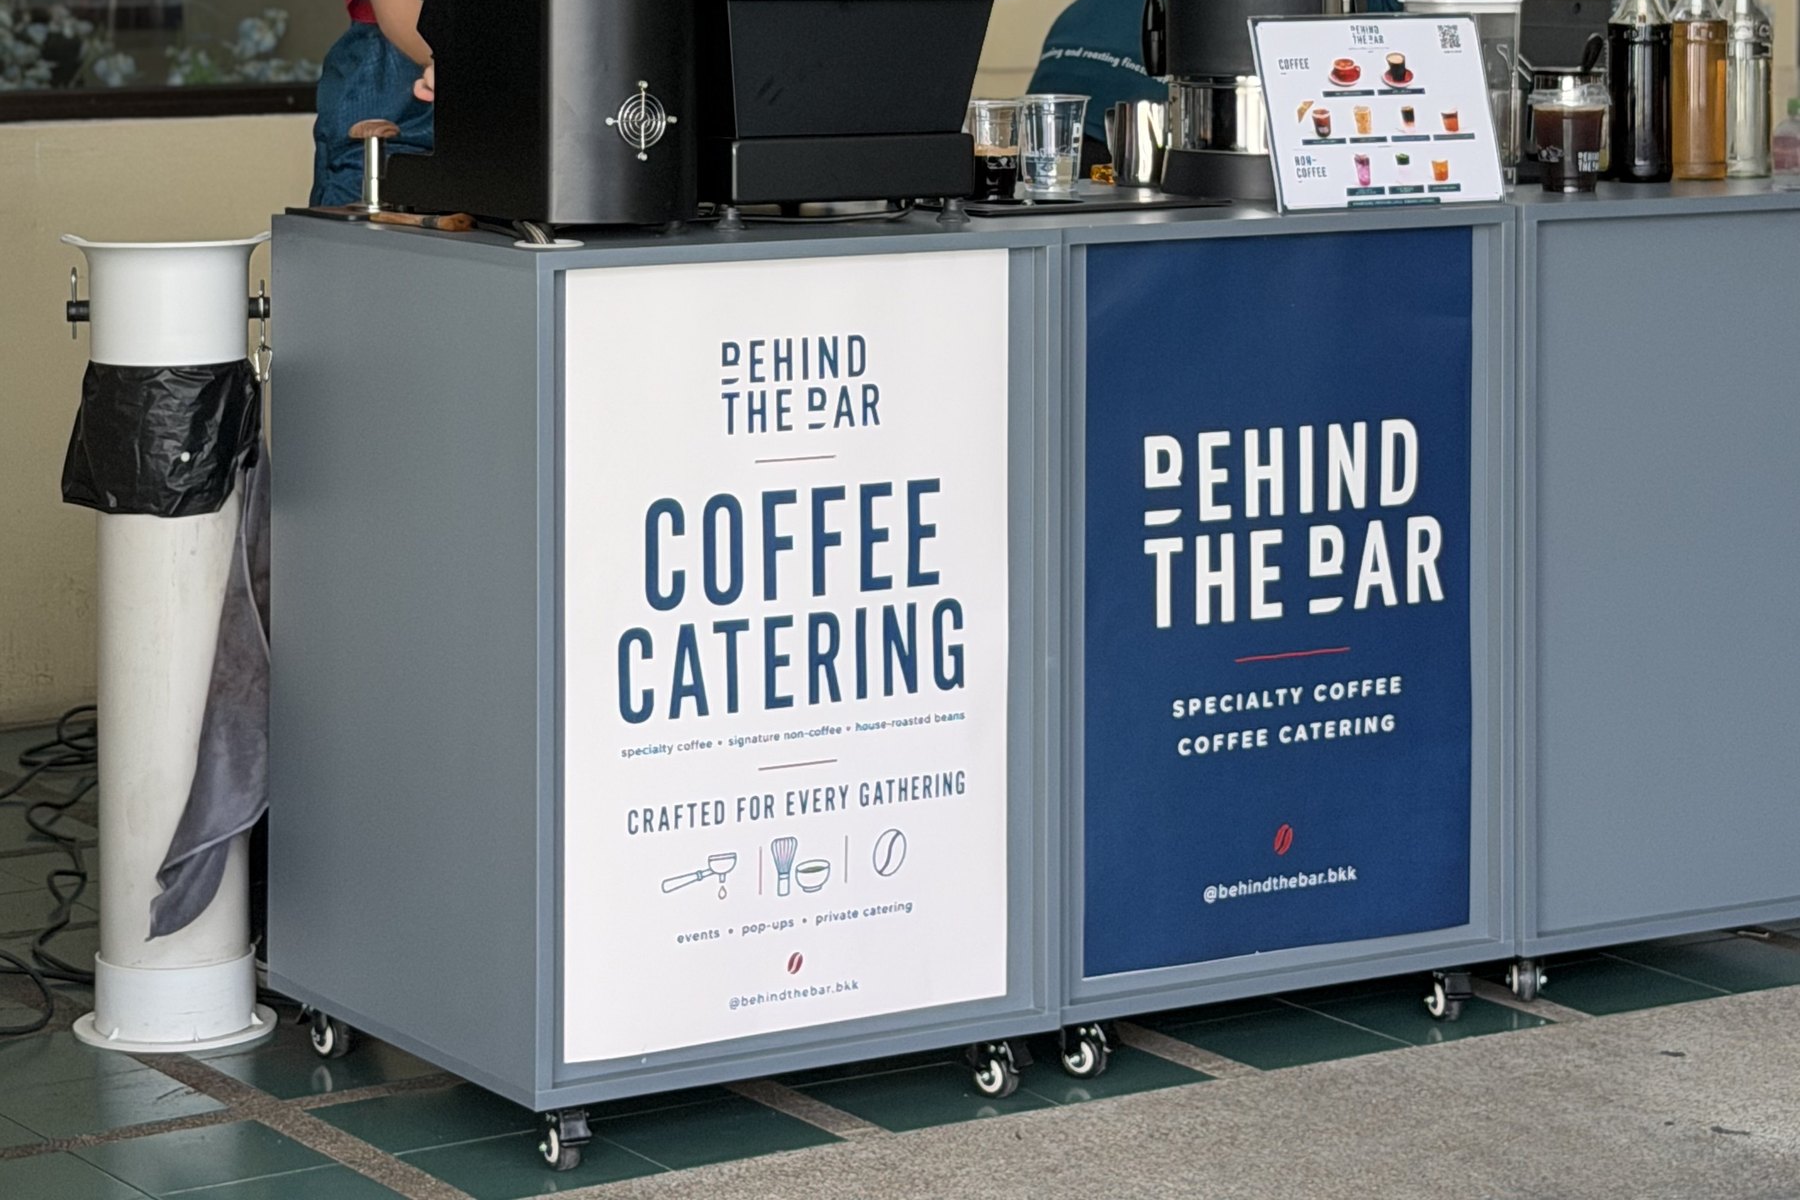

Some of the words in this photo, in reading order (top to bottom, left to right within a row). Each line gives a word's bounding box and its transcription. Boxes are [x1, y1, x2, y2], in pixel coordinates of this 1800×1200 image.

[1121, 57, 1148, 76] fines
[1278, 57, 1310, 70] COFFEE
[1294, 155, 1317, 166] NON-
[1296, 166, 1328, 178] COFFEE
[721, 334, 867, 386] BEHIND
[721, 388, 793, 436] THE
[807, 383, 881, 430] BAR
[1144, 419, 1418, 526] BEHIND
[645, 478, 940, 611] COFFEE
[1144, 528, 1283, 628] THE
[1308, 516, 1444, 614] BAR
[618, 598, 965, 724] CATERING
[1172, 686, 1303, 719] SPECIALTY
[1313, 675, 1403, 703] COFFEE
[621, 742, 674, 759] specialty
[677, 739, 713, 752] coffee
[728, 732, 781, 748] signature
[783, 725, 842, 740] non-coffee
[855, 714, 931, 732] house-roasted
[934, 711, 966, 724] beans
[1177, 728, 1269, 757] COFFEE
[1278, 713, 1396, 745] CATERING
[627, 799, 726, 835] CRAFTED
[736, 794, 775, 823] FOR
[785, 784, 849, 817] EVERY
[859, 770, 966, 808] GATHERING
[1203, 865, 1358, 905] @behindthebar.bkk
[677, 928, 721, 944] events
[741, 918, 795, 937] pop-ups
[815, 908, 859, 927] private
[862, 900, 913, 918] catering
[729, 979, 860, 1010] @behindthebar.bkk
